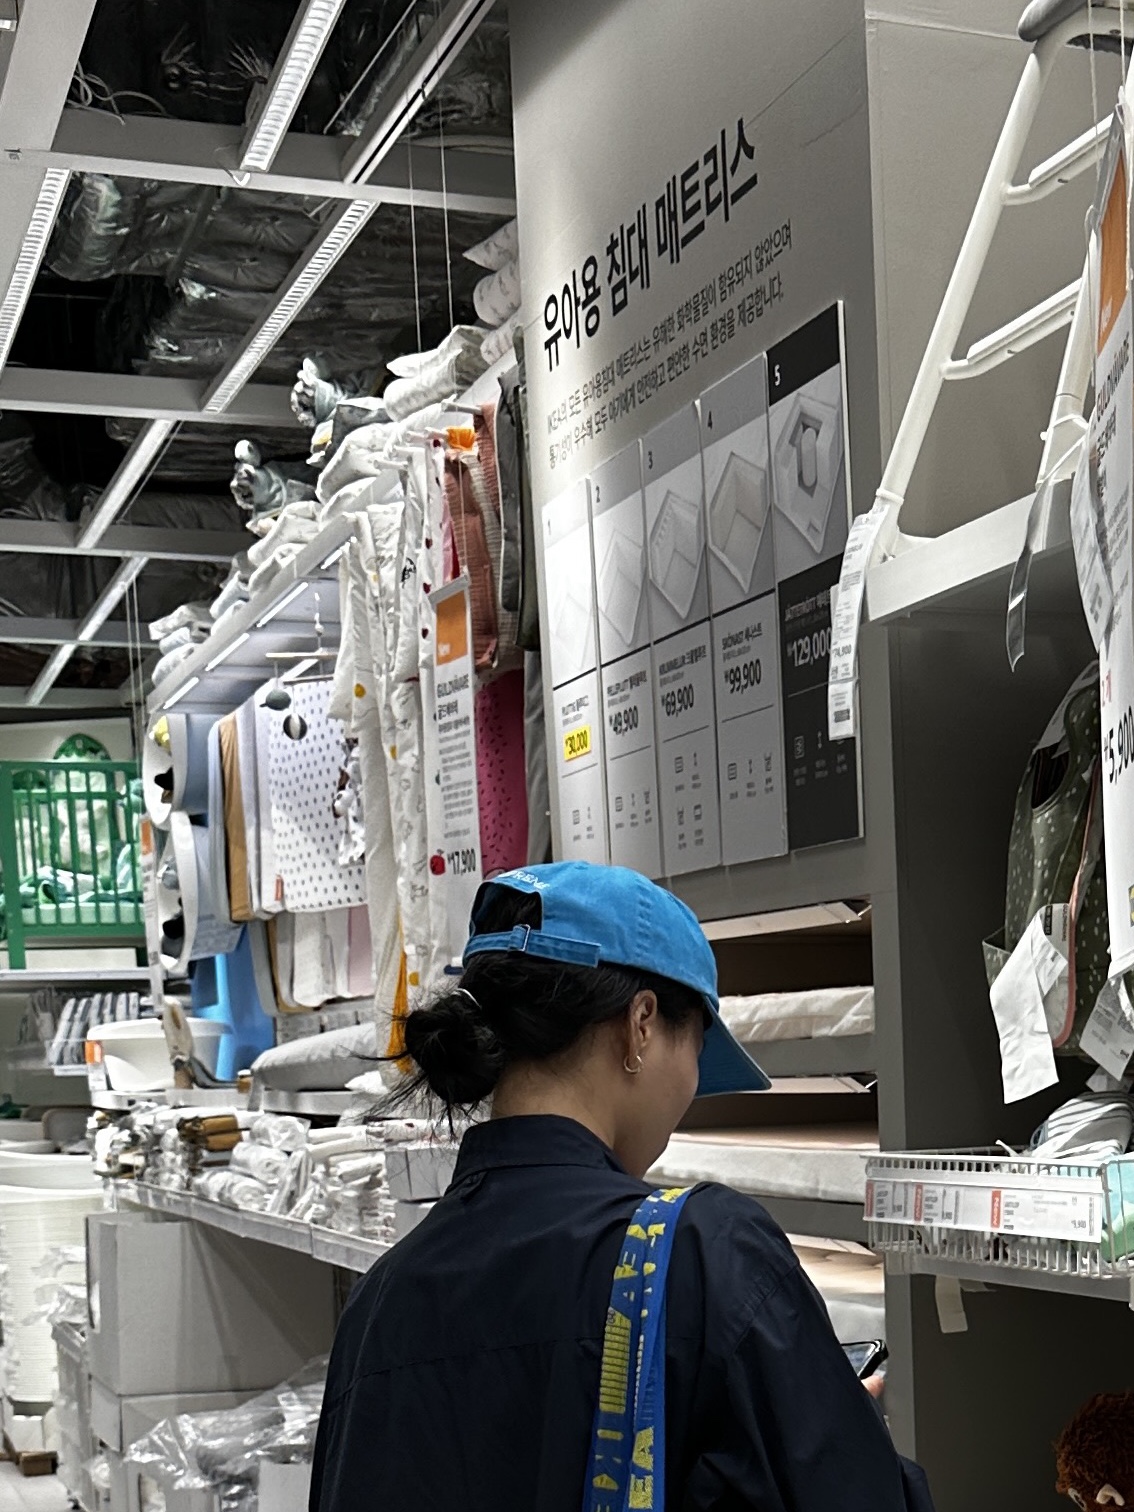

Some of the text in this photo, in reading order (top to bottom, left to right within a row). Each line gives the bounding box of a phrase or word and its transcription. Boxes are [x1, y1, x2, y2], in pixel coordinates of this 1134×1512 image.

[544, 117, 758, 373] 유아용 침대 매트리스
[773, 364, 782, 387] 5
[707, 410, 713, 430] 4
[648, 450, 653, 469] 3
